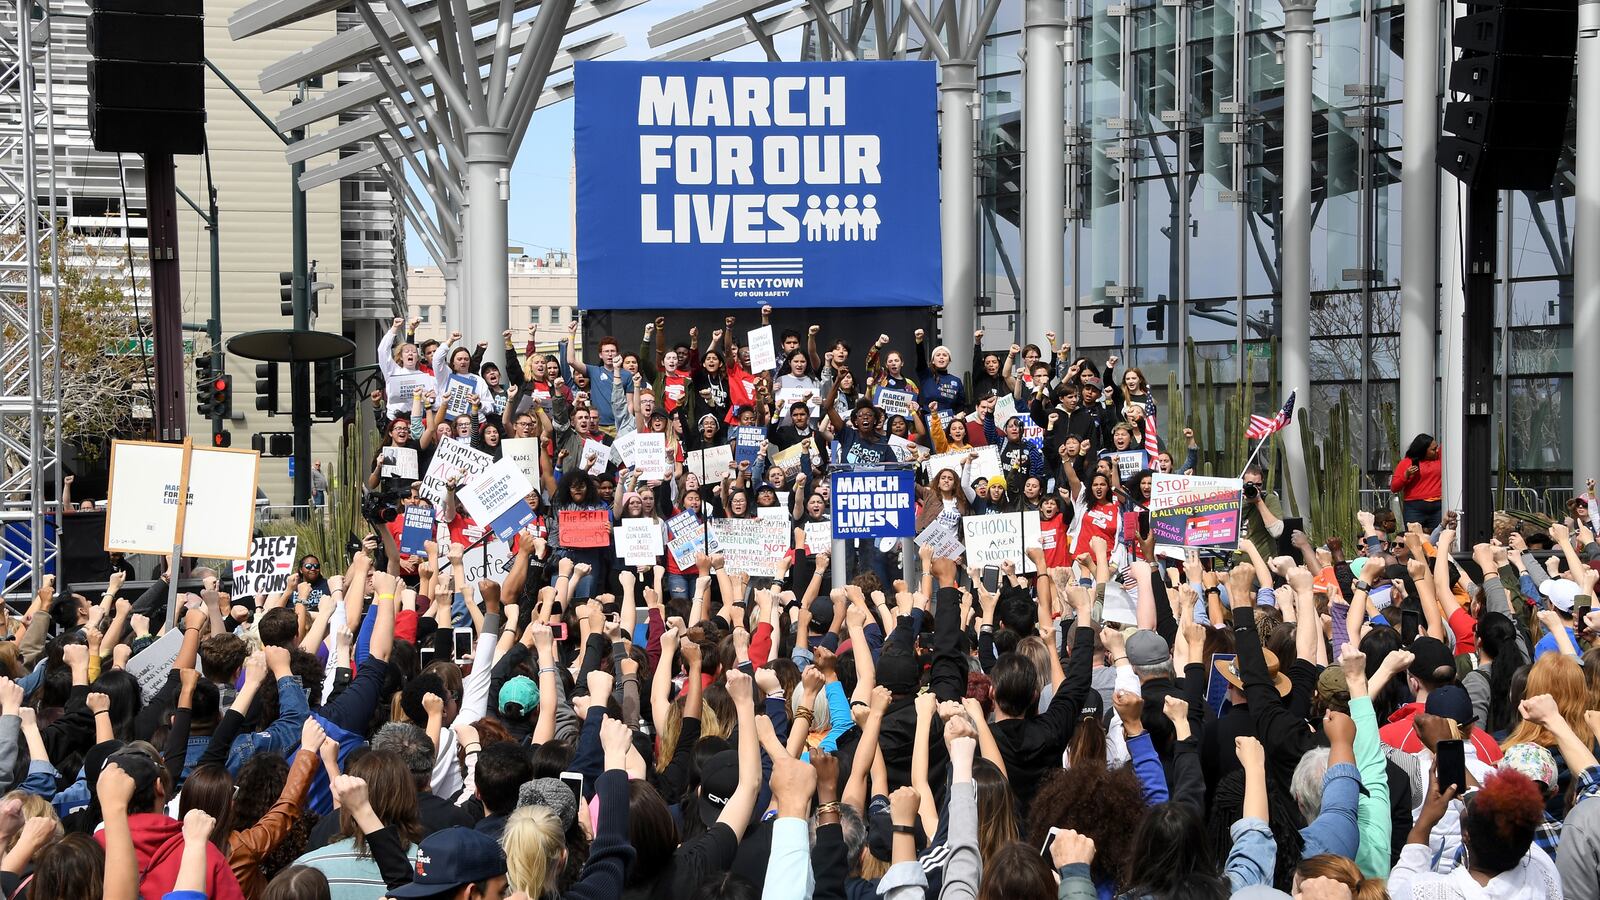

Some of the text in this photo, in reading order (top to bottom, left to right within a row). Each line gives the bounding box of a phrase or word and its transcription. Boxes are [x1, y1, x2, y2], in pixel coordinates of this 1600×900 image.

[638, 76, 846, 126] MARCH
[640, 135, 881, 184] FOR OUR
[641, 194, 801, 243] LIVES
[721, 278, 803, 289] EVERYTOWN
[453, 385, 465, 412] FOR OUR
[881, 399, 895, 409] FOR
[882, 392, 906, 402] MARCH
[441, 437, 490, 468] Promises
[423, 475, 445, 491] are
[478, 474, 512, 501] STUDENTS
[837, 476, 898, 492] MARCH
[1156, 479, 1190, 492] STOP
[164, 490, 178, 498] FOR
[481, 484, 509, 506] DEMAND
[486, 492, 509, 511] ACTION
[837, 493, 910, 510] FOR OUR
[1152, 496, 1174, 508] THE
[1176, 493, 1201, 505] GUN
[406, 513, 419, 522] FOR
[407, 506, 431, 516] MARCH
[941, 510, 961, 521] Silv
[1151, 510, 1158, 518] &
[1159, 508, 1173, 517] ALL
[1174, 506, 1193, 515] WHO
[1195, 502, 1228, 513] SUPPORT
[405, 521, 421, 529] LIVES
[763, 520, 775, 528] SAY
[775, 520, 790, 528] THAT
[837, 511, 886, 528] LIVES
[1156, 520, 1181, 533] VEGAS
[741, 526, 764, 534] RANKED
[966, 519, 1018, 538] SCHOOLS
[1153, 528, 1184, 542] STRONG!
[718, 535, 738, 544] GREEN
[738, 536, 760, 545] LIVING
[935, 540, 953, 557] CHANGE
[246, 556, 275, 575] KIDS
[466, 553, 506, 582] safe
[254, 573, 291, 594] GUNS
